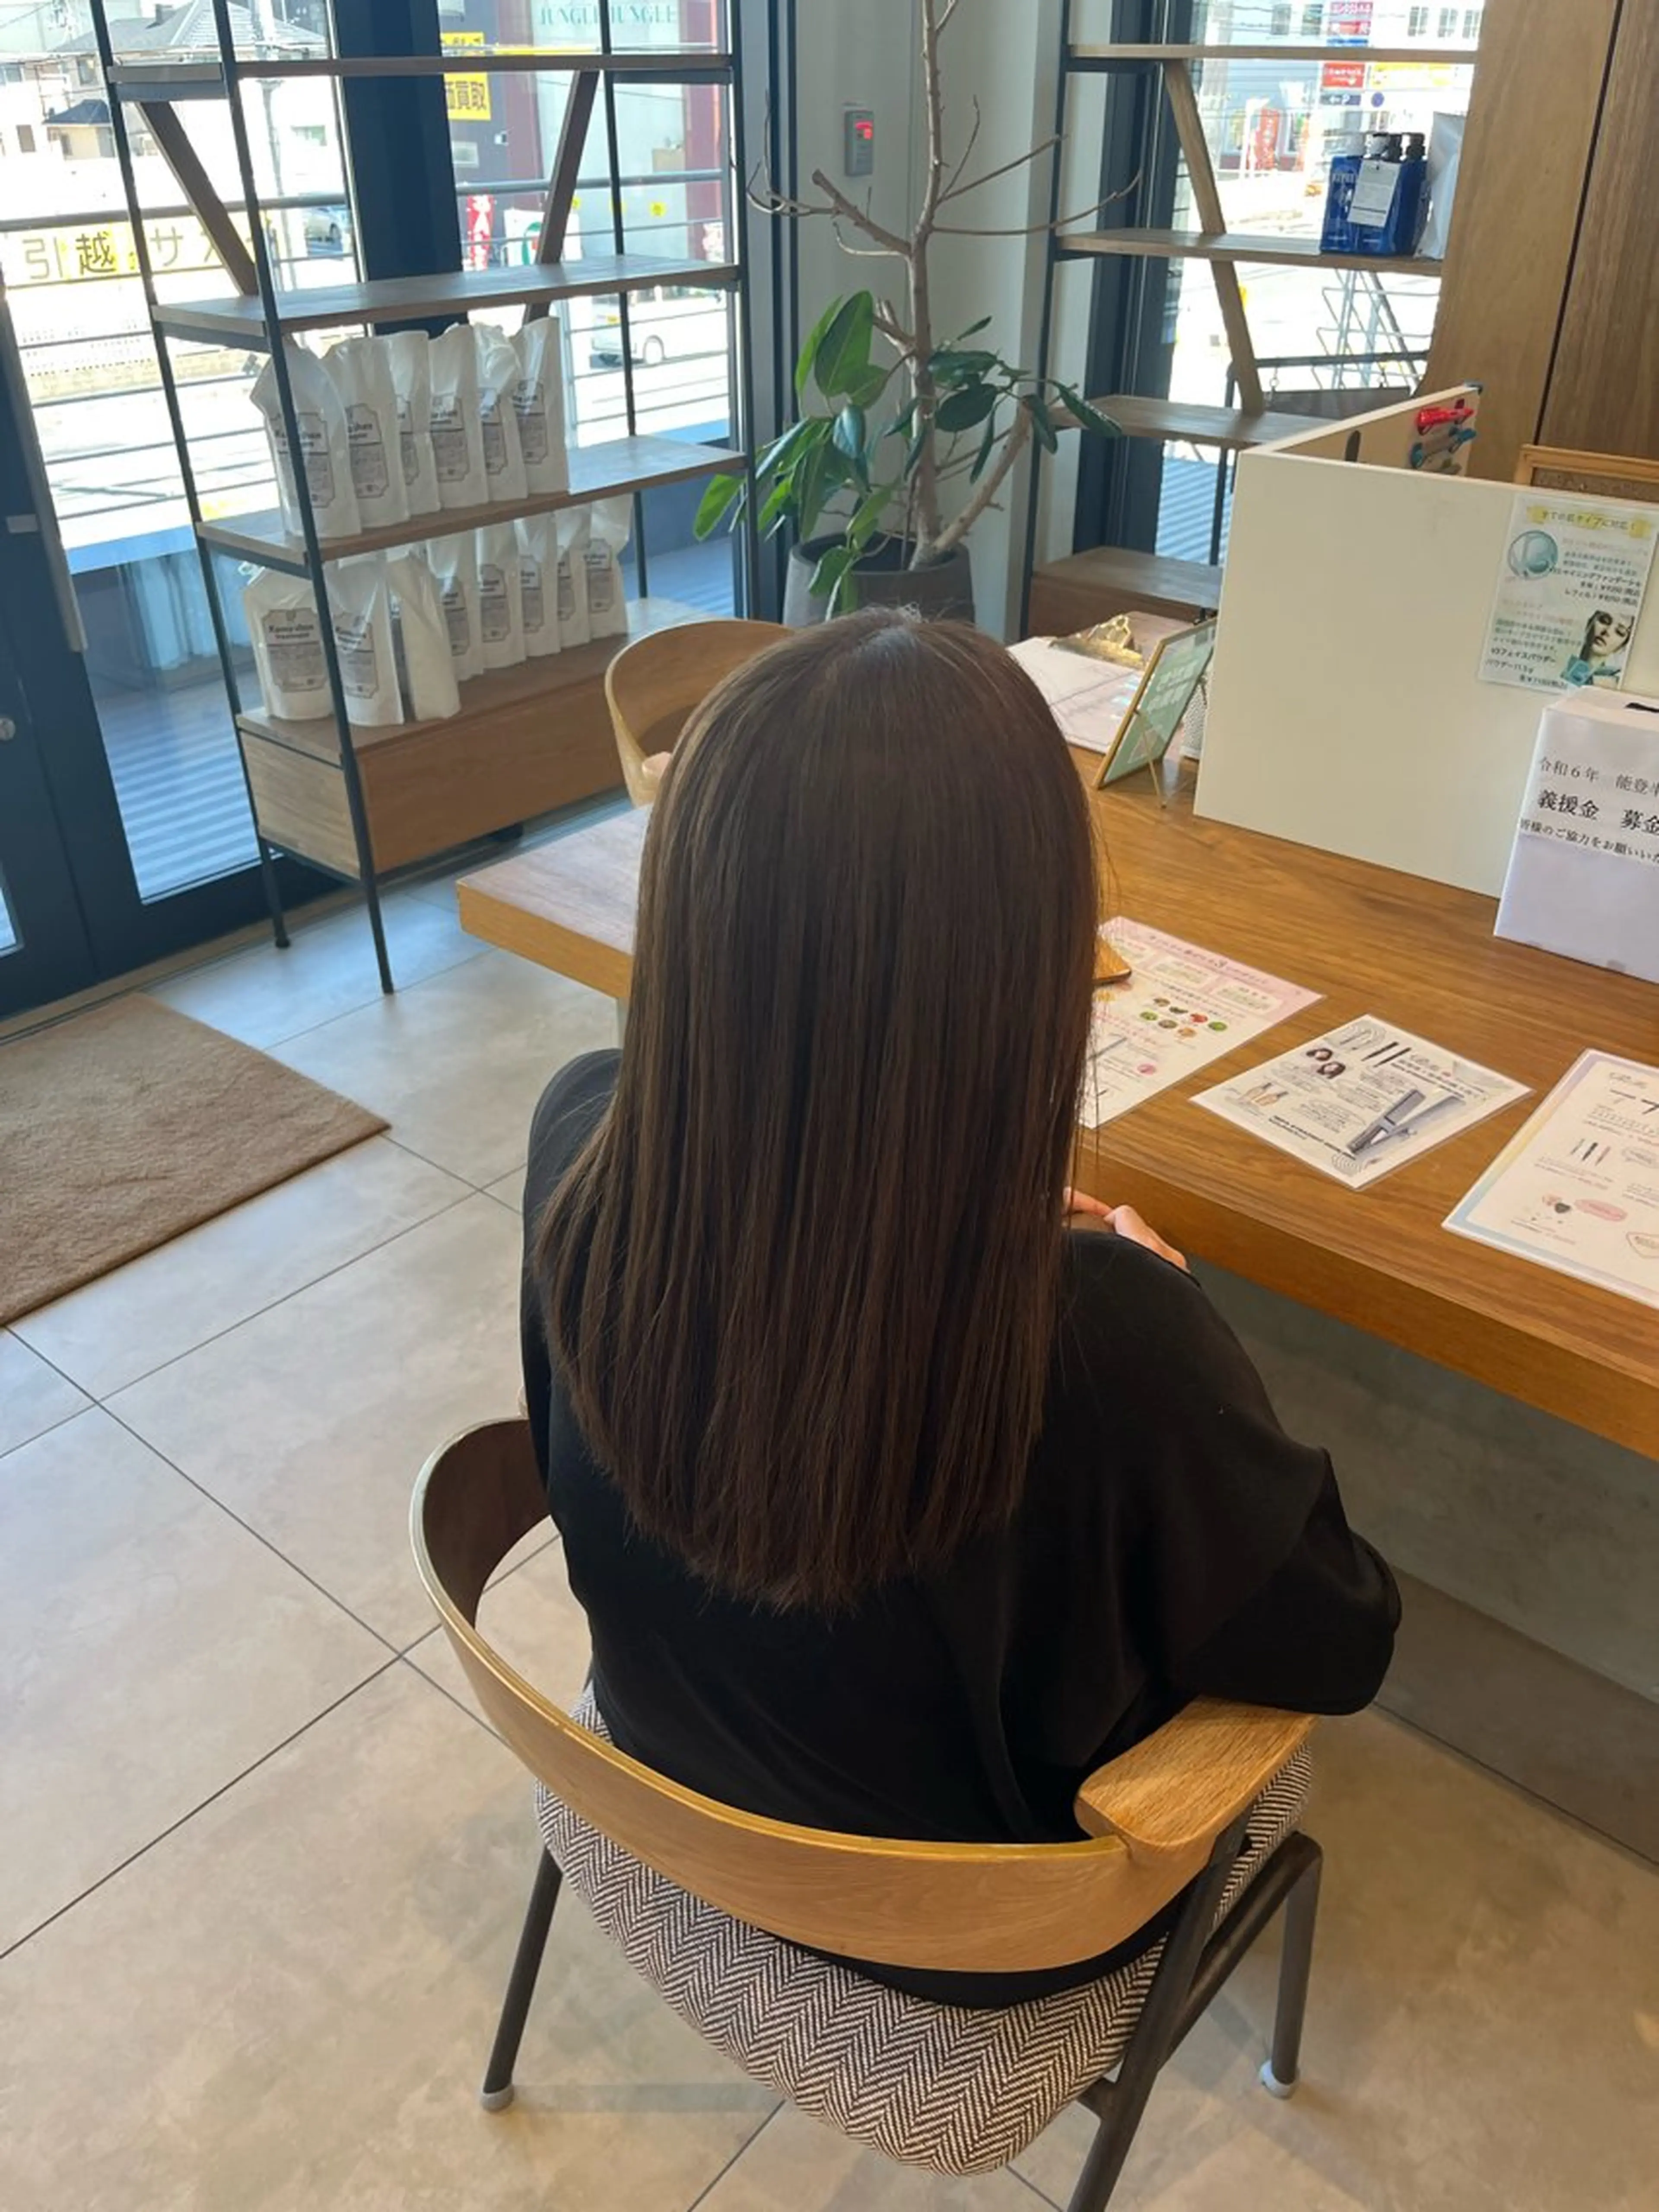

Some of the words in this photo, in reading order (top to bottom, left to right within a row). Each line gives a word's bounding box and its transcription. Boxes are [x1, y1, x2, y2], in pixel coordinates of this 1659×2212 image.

[1537, 789, 1599, 820] 義援金
[1621, 808, 1659, 836] 募金
